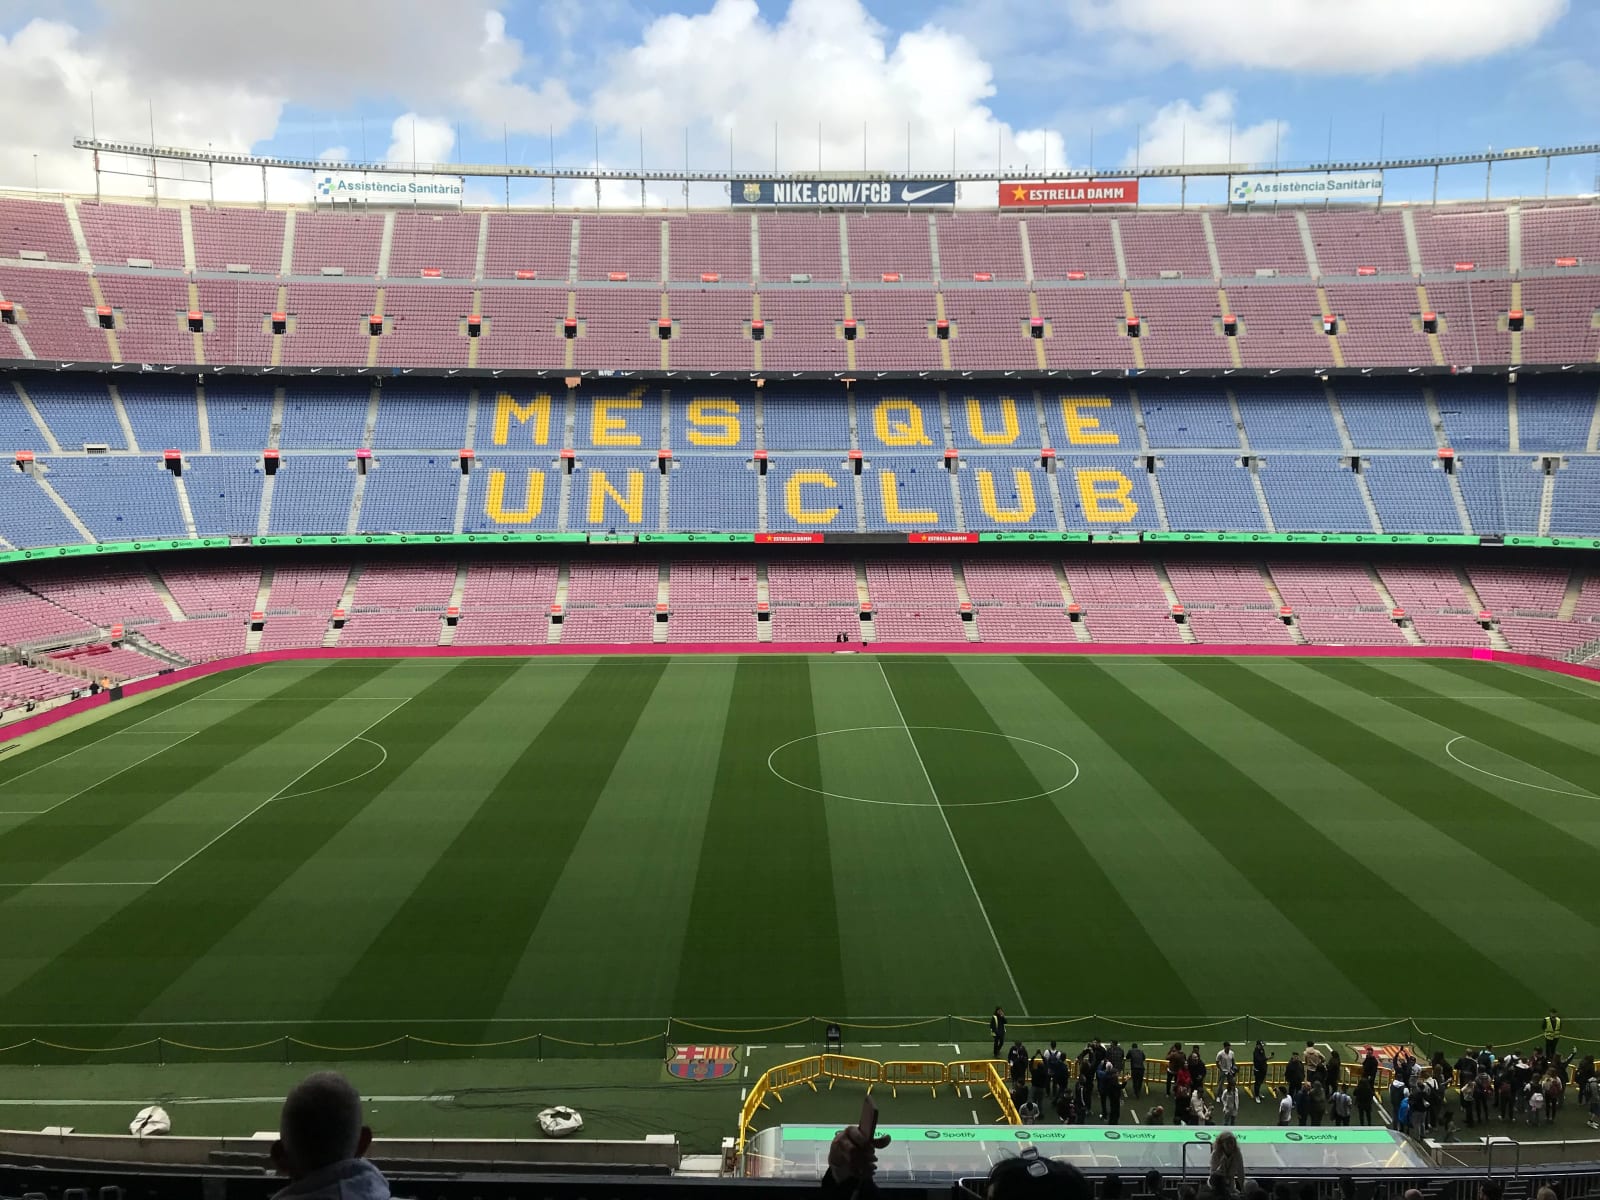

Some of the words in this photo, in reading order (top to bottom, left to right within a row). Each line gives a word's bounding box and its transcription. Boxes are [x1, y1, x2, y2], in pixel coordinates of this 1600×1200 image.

[338, 180, 406, 193] Assistència
[408, 183, 460, 194] Sanitària
[773, 183, 891, 203] NIKE.COM/FCB
[1029, 188, 1085, 201] ESTRELLA
[1087, 187, 1125, 199] DAMM
[1254, 181, 1325, 193] Assistència
[1327, 179, 1382, 191] Sanitària
[873, 396, 1120, 446] QUE
[486, 468, 644, 524] UN
[785, 468, 1139, 523] CLUB
